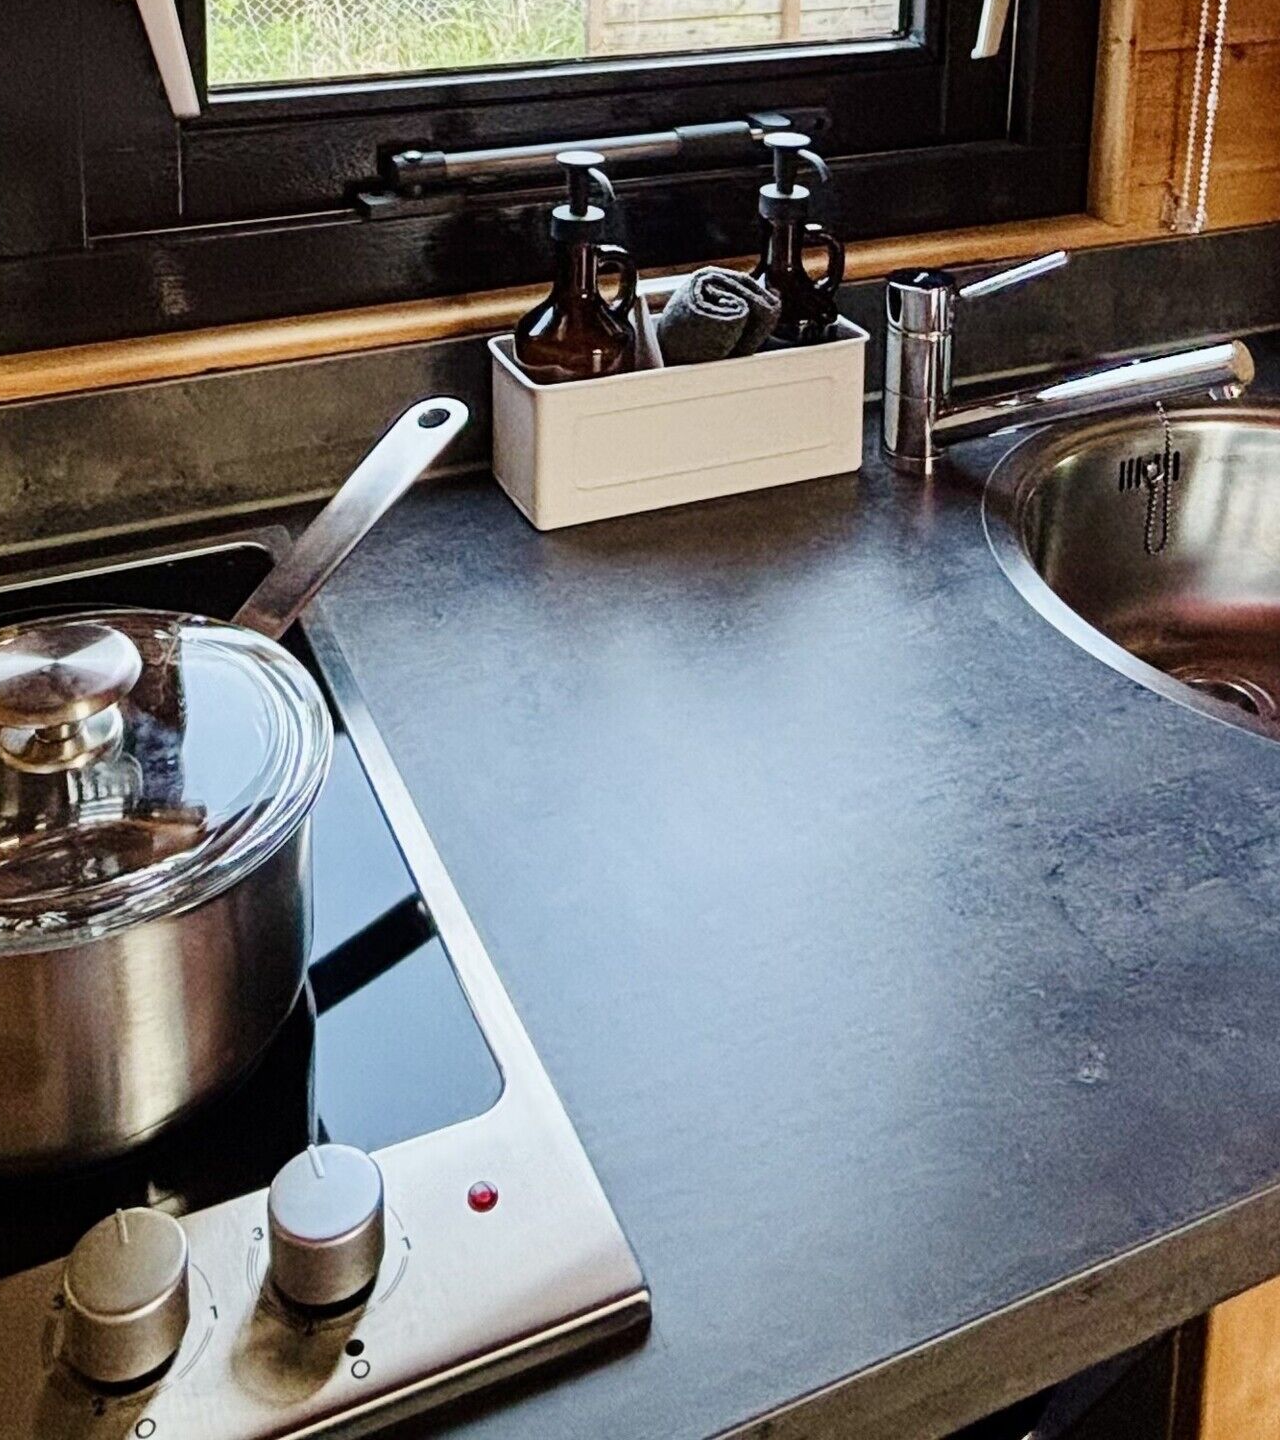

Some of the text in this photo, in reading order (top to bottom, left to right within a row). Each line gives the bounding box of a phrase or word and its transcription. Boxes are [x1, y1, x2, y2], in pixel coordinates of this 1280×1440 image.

[252, 1226, 264, 1241] 3
[402, 1236, 412, 1250] 1
[210, 1305, 218, 1320] 1
